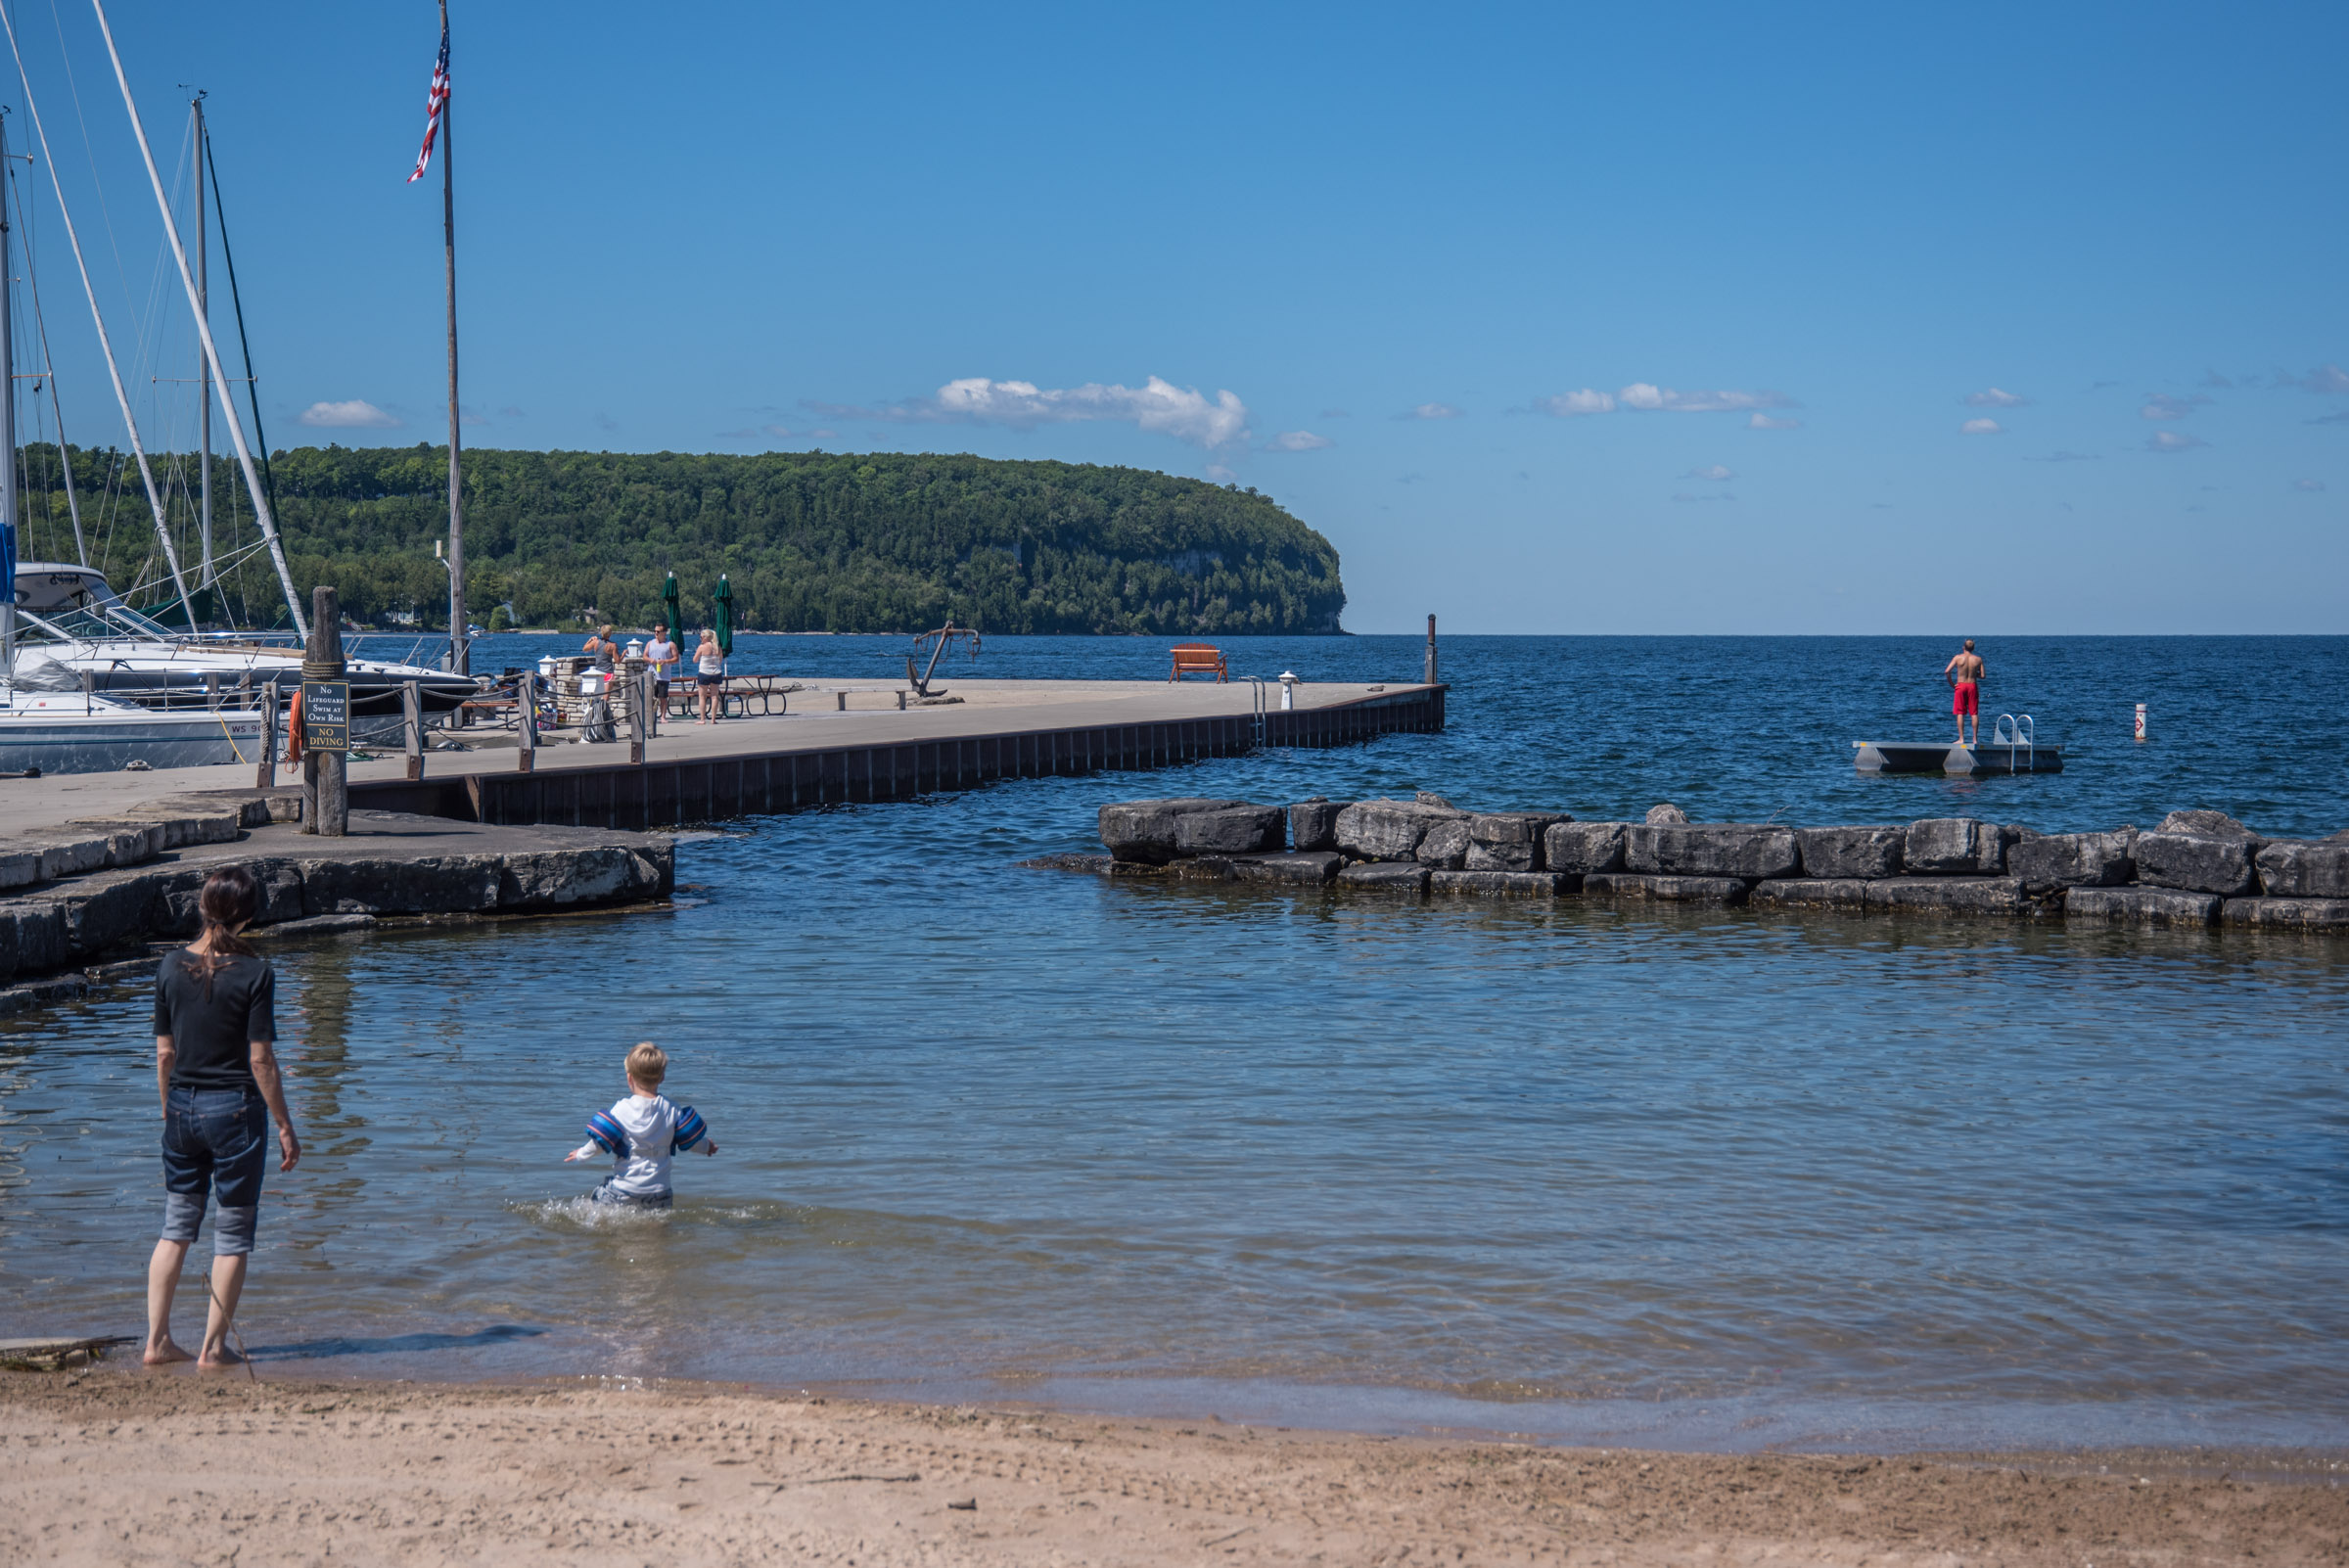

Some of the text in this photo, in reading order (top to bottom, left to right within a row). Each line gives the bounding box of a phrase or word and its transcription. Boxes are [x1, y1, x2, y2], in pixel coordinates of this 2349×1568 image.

[231, 724, 247, 733] WS
[318, 727, 334, 736] NO
[309, 736, 344, 746] DIVING
